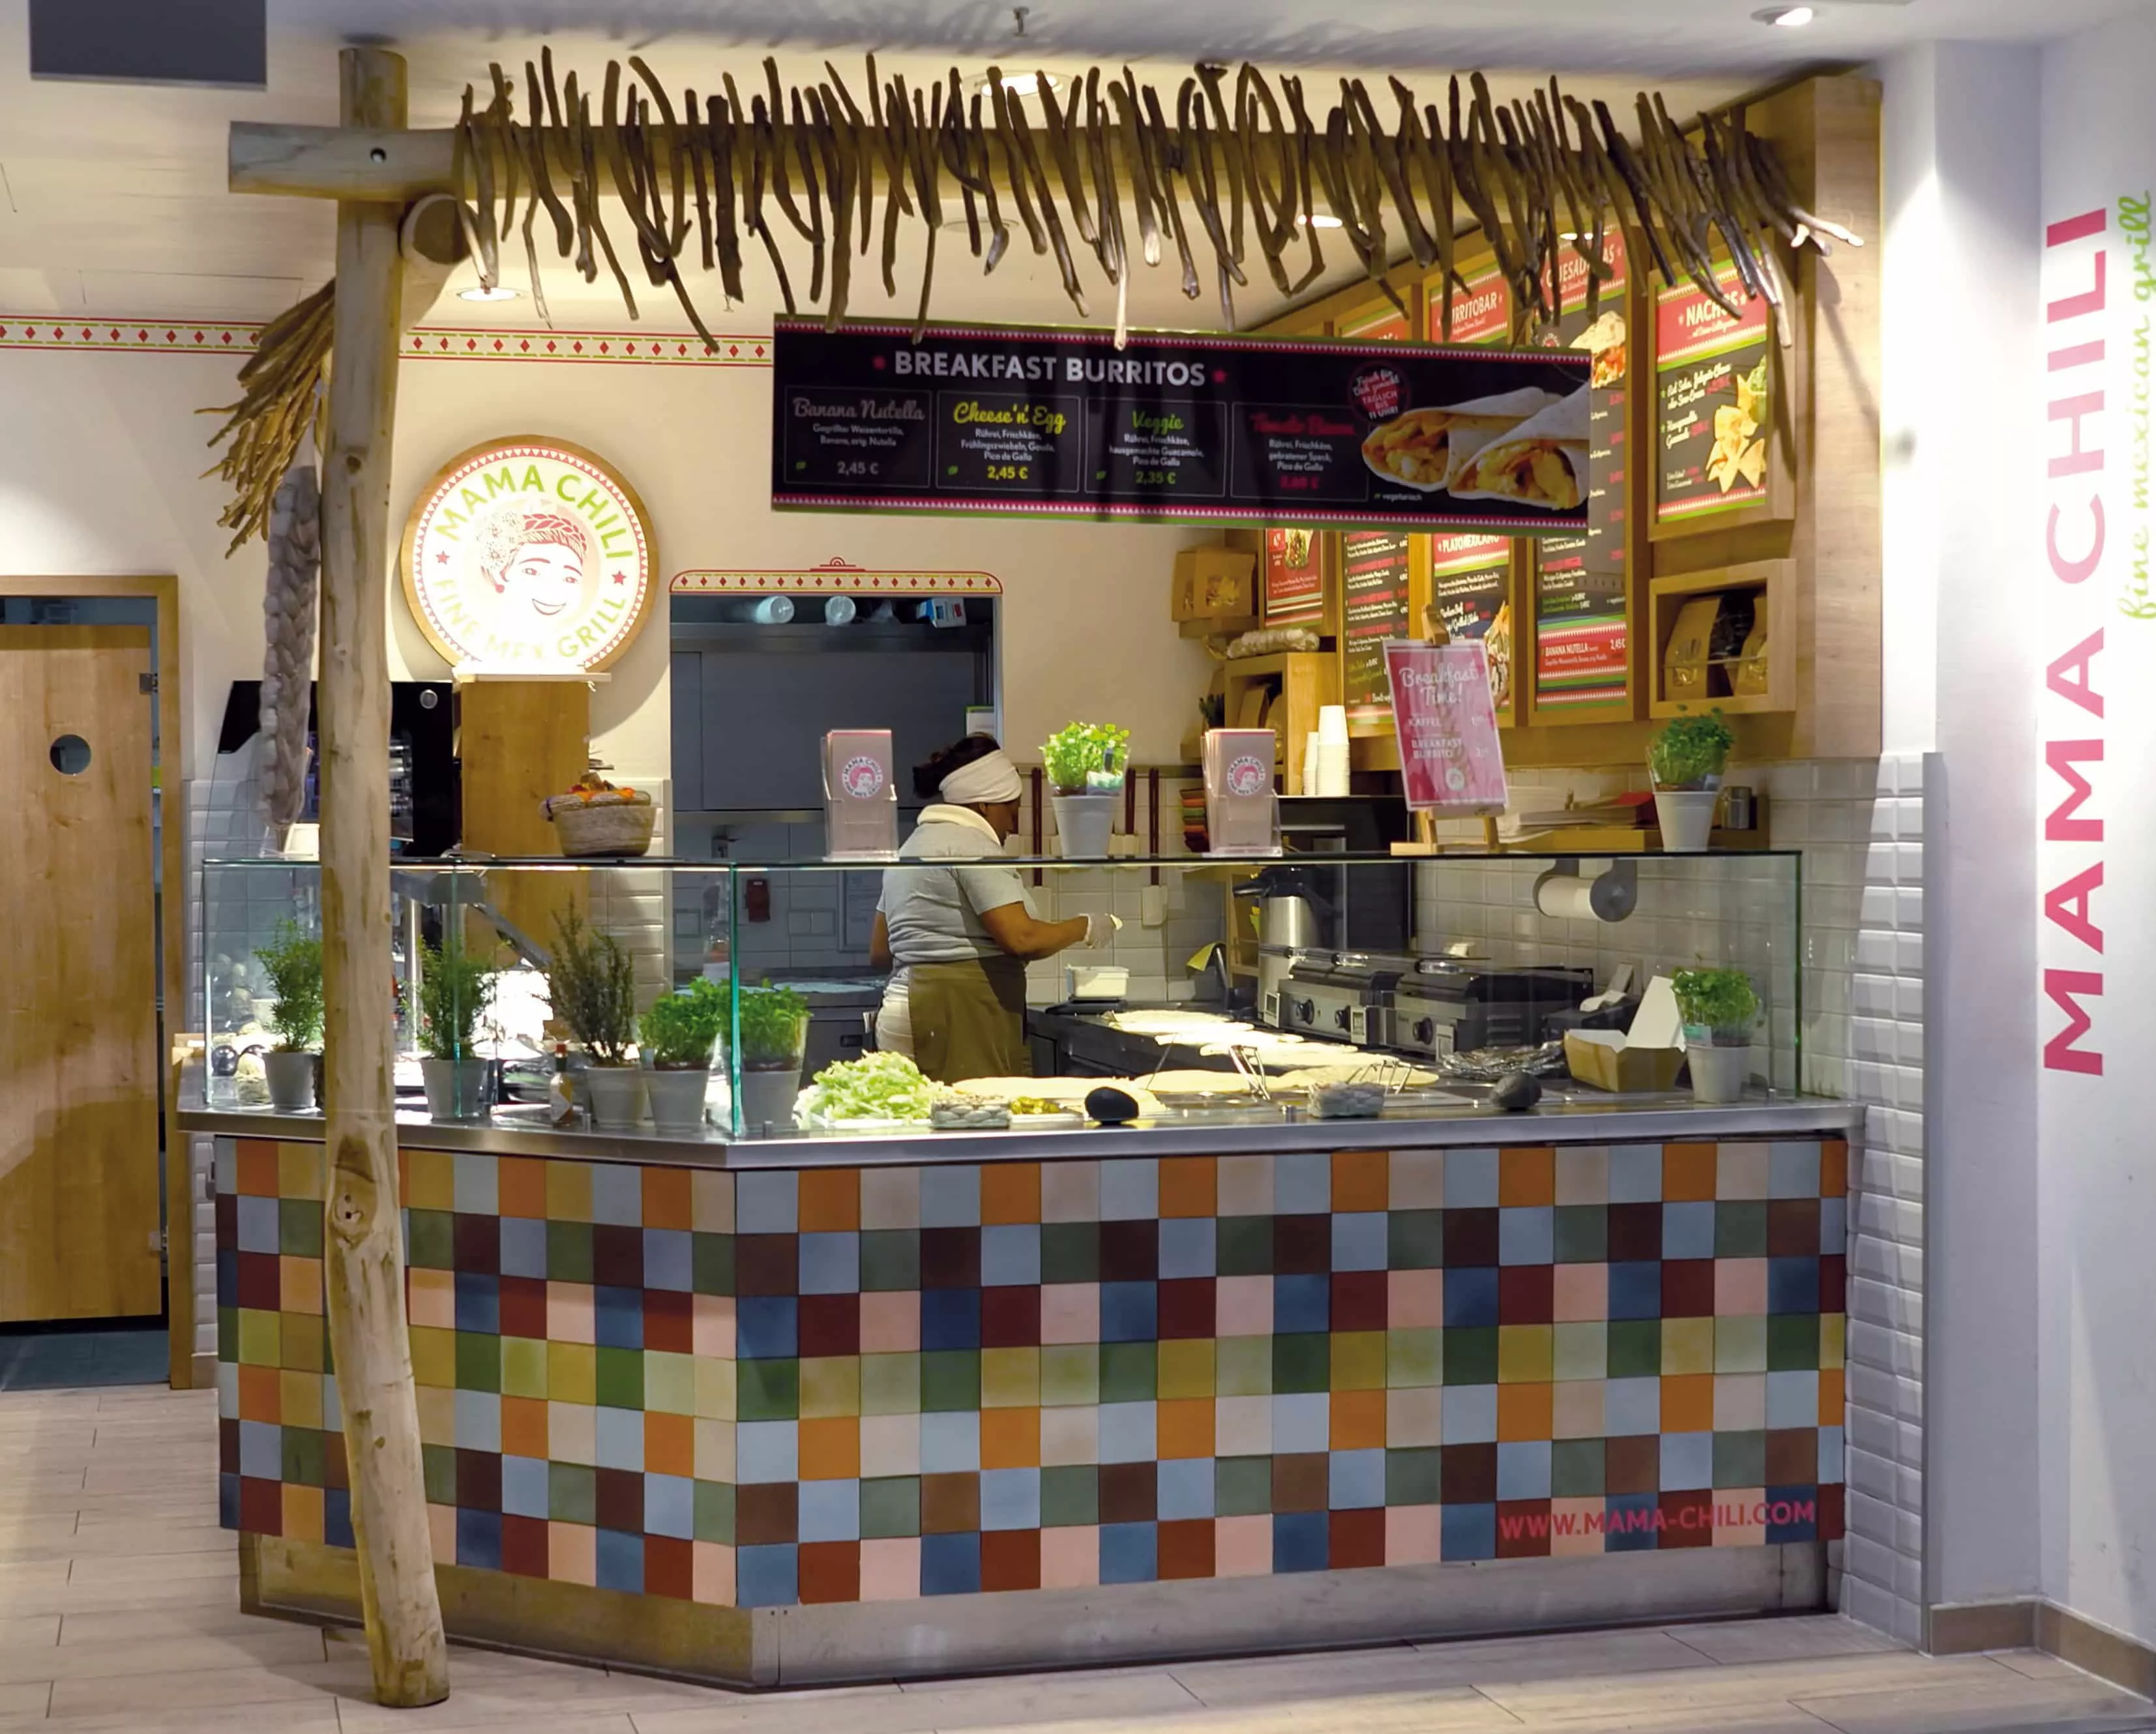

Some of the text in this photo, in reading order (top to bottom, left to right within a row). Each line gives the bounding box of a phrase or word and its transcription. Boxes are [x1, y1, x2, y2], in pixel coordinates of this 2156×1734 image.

[1451, 292, 1497, 323] RRITOBAR
[895, 351, 1205, 386] BREAKFAST BURRITOS
[793, 398, 925, 420] Banana Nutella
[2118, 190, 2156, 619] fine mexican grill
[1033, 405, 1067, 435] Egg
[1132, 409, 1185, 435] Veggie
[837, 461, 879, 476] 2,45 €
[986, 465, 1028, 480] 2,45 €
[1167, 471, 1176, 484] €
[434, 465, 634, 559] MAMA CHILI
[434, 579, 480, 640] FINE
[557, 597, 627, 658] GRILL
[2044, 208, 2106, 1076] MAMA CHILI
[1399, 659, 1479, 688] Breakfast
[1421, 683, 1463, 705] Time!
[1411, 738, 1462, 749] BREAKFAST
[844, 757, 863, 774] MAMA
[1228, 757, 1248, 774] MAMA
[1500, 1501, 1815, 1540] WWW.MAMA-CHILI.COM
